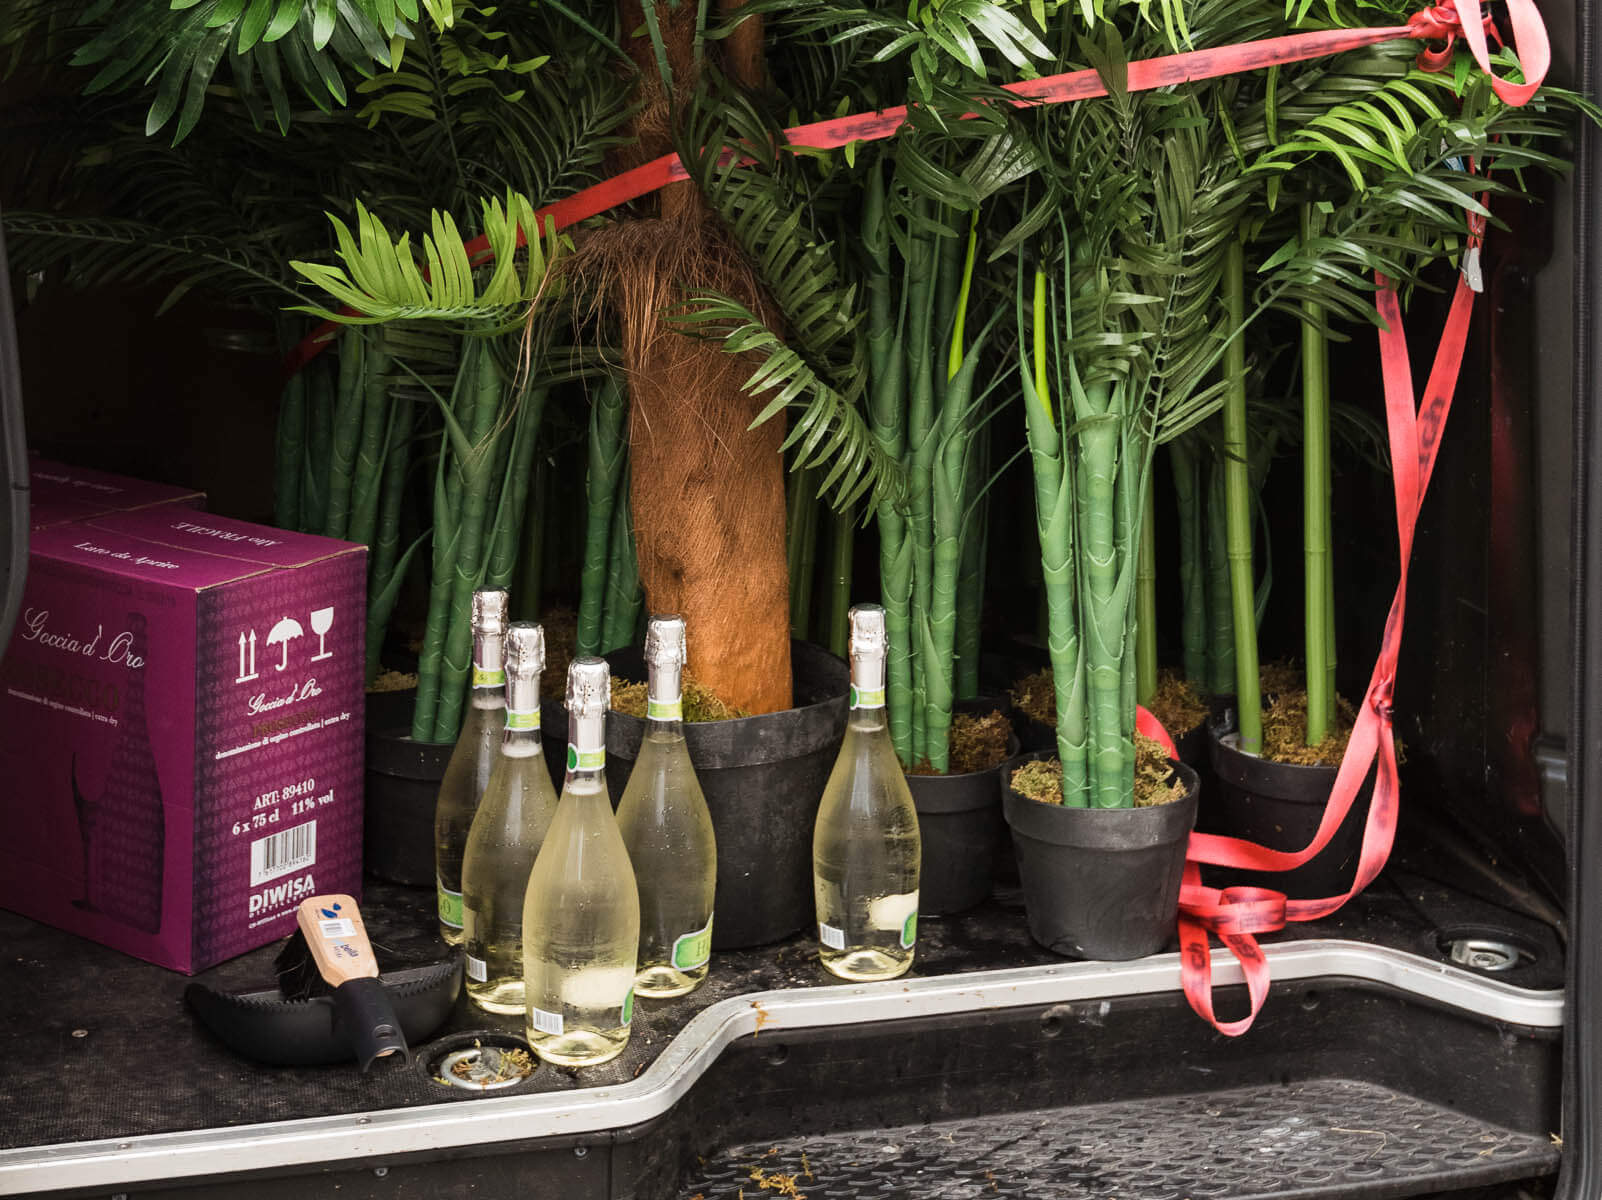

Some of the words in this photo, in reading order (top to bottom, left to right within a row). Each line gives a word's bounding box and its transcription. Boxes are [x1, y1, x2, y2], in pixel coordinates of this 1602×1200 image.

[22, 607, 81, 653] Goccia
[232, 821, 240, 835] 6
[242, 822, 250, 833] x
[252, 813, 267, 829] 75
[268, 808, 280, 823] cl
[291, 796, 315, 816] 11%
[317, 789, 334, 807] vol
[282, 778, 315, 801] 89410
